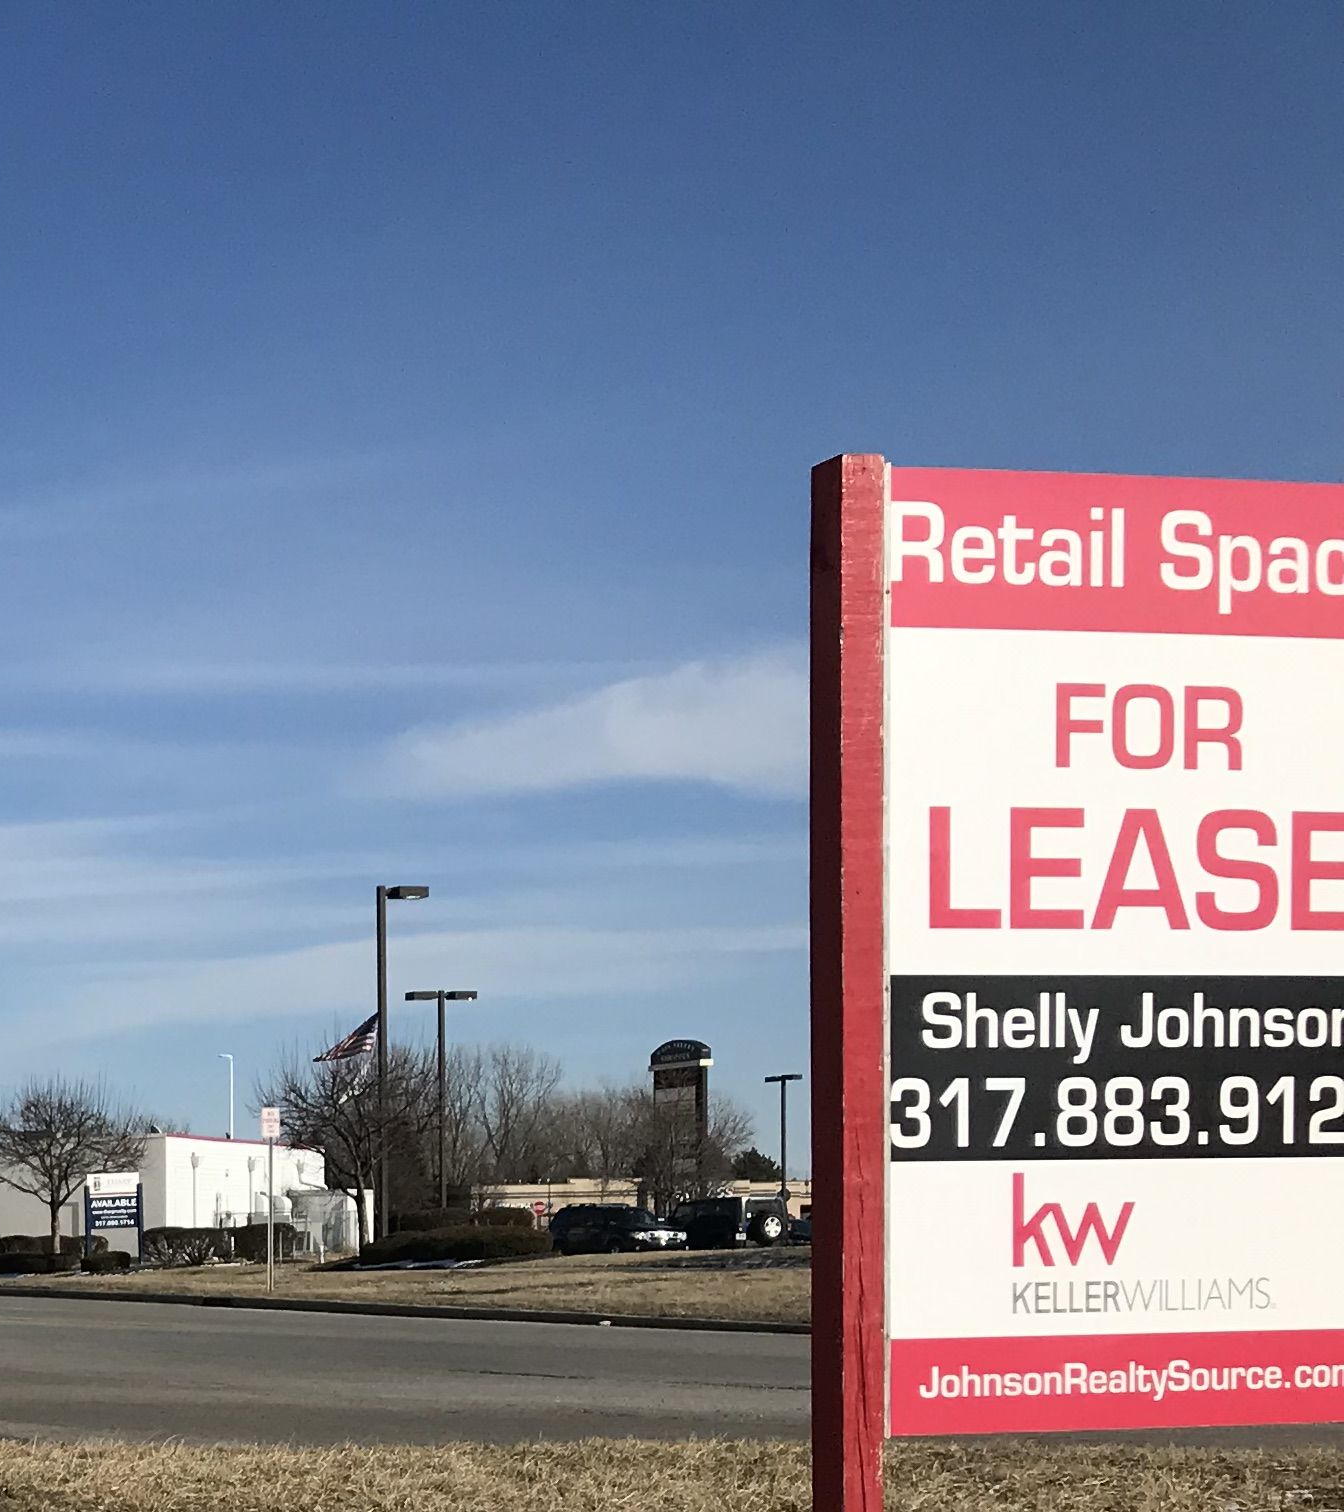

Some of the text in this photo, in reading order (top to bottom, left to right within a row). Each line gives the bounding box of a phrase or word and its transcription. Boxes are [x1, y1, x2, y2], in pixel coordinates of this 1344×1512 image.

[891, 500, 1344, 614] Retail Spac
[1055, 682, 1243, 771] FOR
[928, 806, 1344, 931] LEASE
[921, 991, 1099, 1065] Shelly
[891, 1076, 1344, 1149] 317.883.912
[91, 1198, 137, 1208] AVAILABLE
[1012, 1172, 1135, 1267] kw
